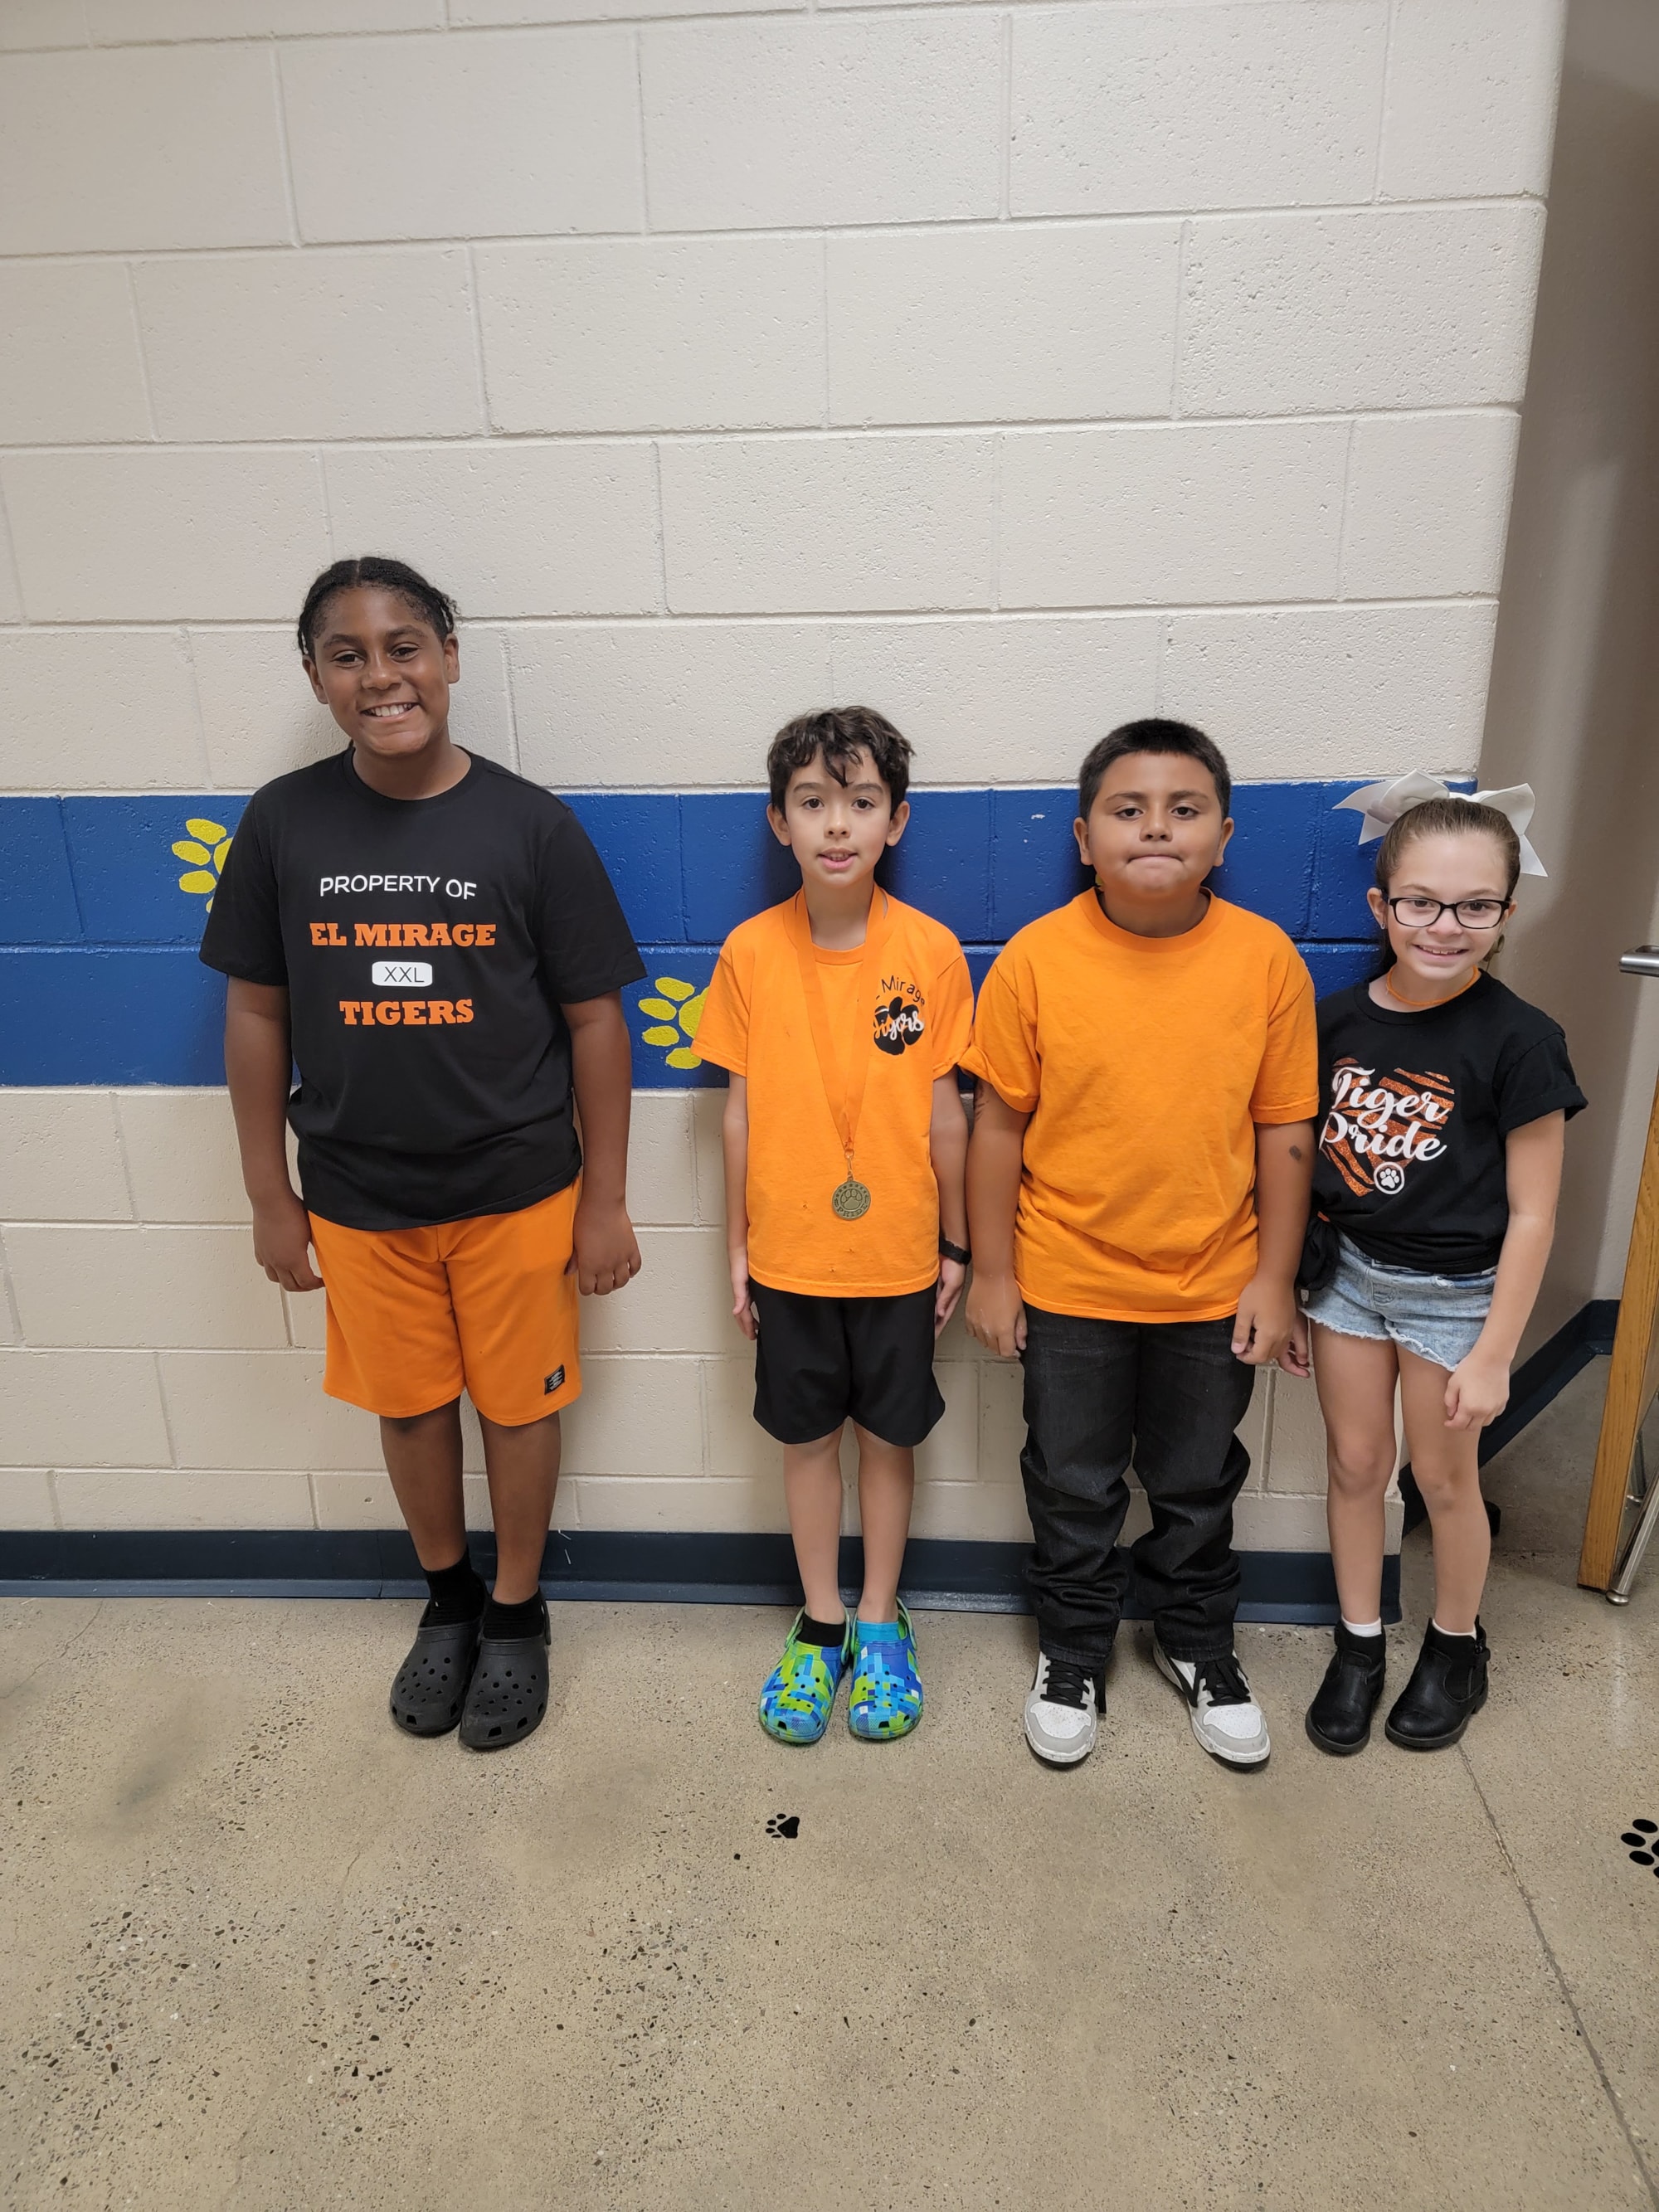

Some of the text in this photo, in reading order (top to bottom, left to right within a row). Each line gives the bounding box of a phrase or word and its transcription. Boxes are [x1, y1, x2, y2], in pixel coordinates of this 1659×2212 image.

[320, 875, 478, 900] PROPERTY OF
[309, 922, 497, 947] EL MIRAGE
[383, 966, 426, 983] XXL
[338, 999, 474, 1026] TIGERS
[1332, 1067, 1450, 1129] Tiger
[1318, 1111, 1447, 1162] Pride
[837, 1203, 868, 1217] PRIDE
